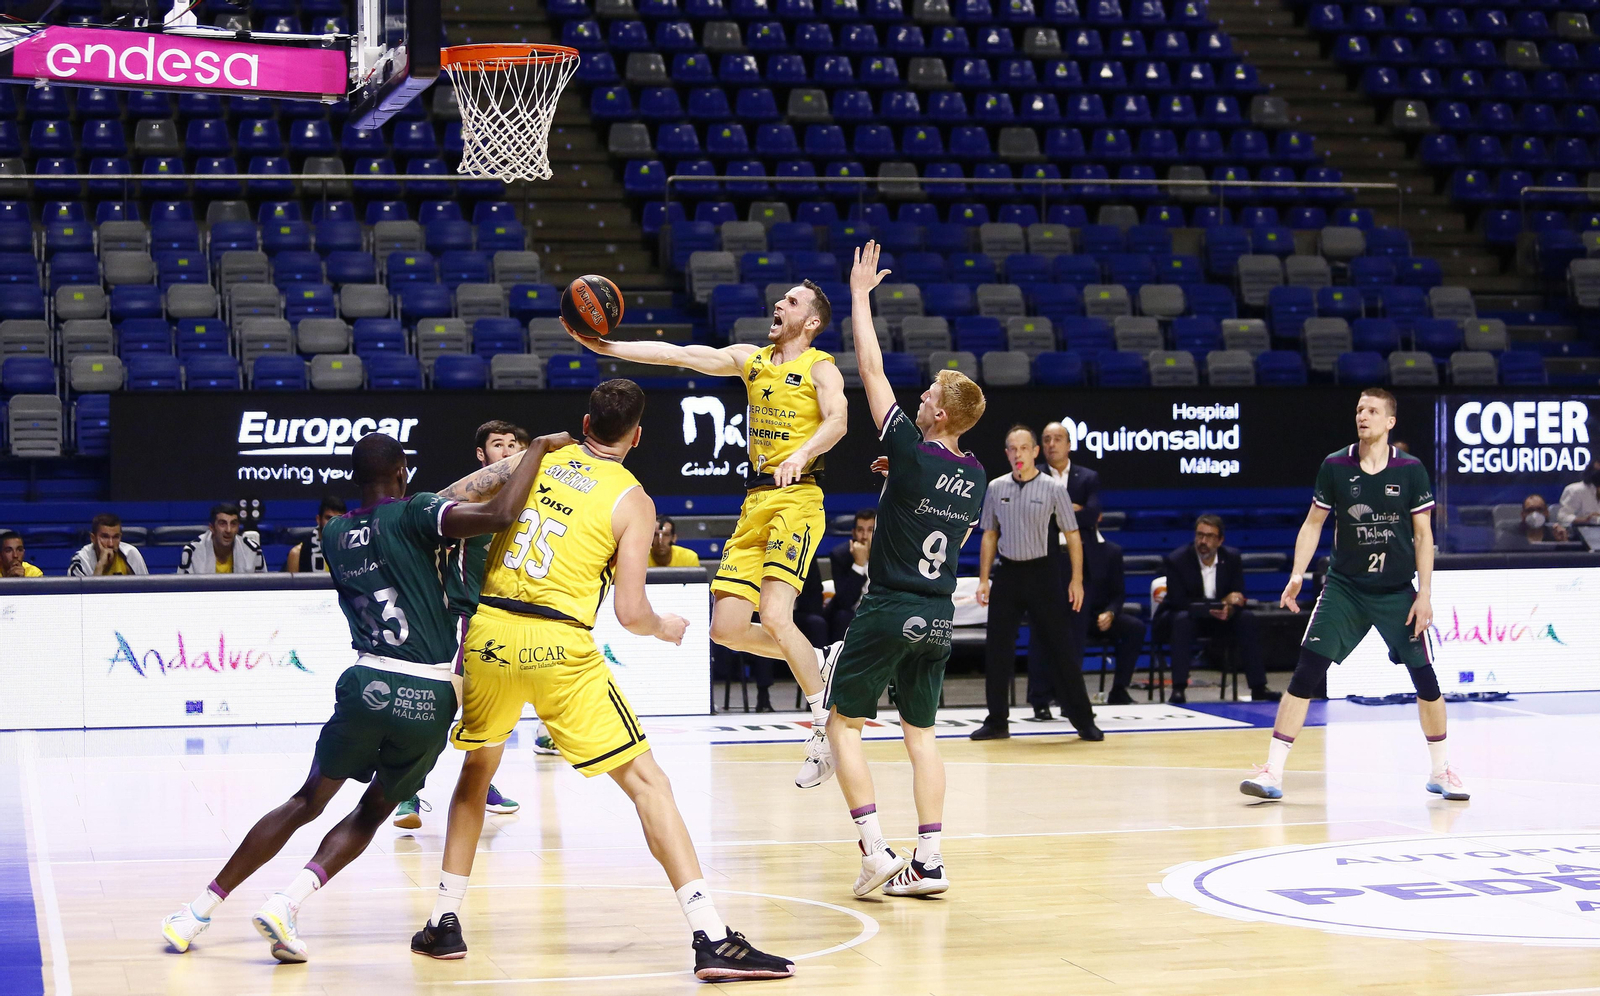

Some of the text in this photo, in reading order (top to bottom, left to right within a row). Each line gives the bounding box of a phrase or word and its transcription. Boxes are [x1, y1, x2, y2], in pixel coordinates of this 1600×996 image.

[46, 36, 259, 87] endesa
[576, 283, 605, 326] SPALDING
[749, 404, 797, 419] EROSTAR
[1172, 402, 1240, 423] Hospital
[237, 410, 419, 455] Europcar
[749, 427, 790, 441] ENERIFE
[1454, 401, 1590, 446] COFER
[1085, 424, 1240, 460] quirónsalud
[681, 461, 730, 476] Ciudad
[1180, 457, 1240, 478] Málaga
[1457, 447, 1591, 474] SEGURIDAD
[237, 463, 314, 485] moving
[544, 464, 598, 494] GUERRA
[935, 473, 975, 499] DÍAZ
[503, 507, 568, 580] 35
[1356, 526, 1397, 544] Málaga
[918, 530, 948, 580] 9
[1367, 552, 1387, 574] 21
[930, 629, 944, 637] DEL
[1430, 604, 1568, 648] ndalucía
[106, 630, 315, 678] Andalucía
[518, 645, 567, 664] CICAR
[520, 663, 537, 671] Canary
[538, 661, 556, 669] Islands
[394, 698, 436, 711] DEL SOL
[397, 687, 436, 700] COSTA
[392, 708, 436, 720] MÁLAGA
